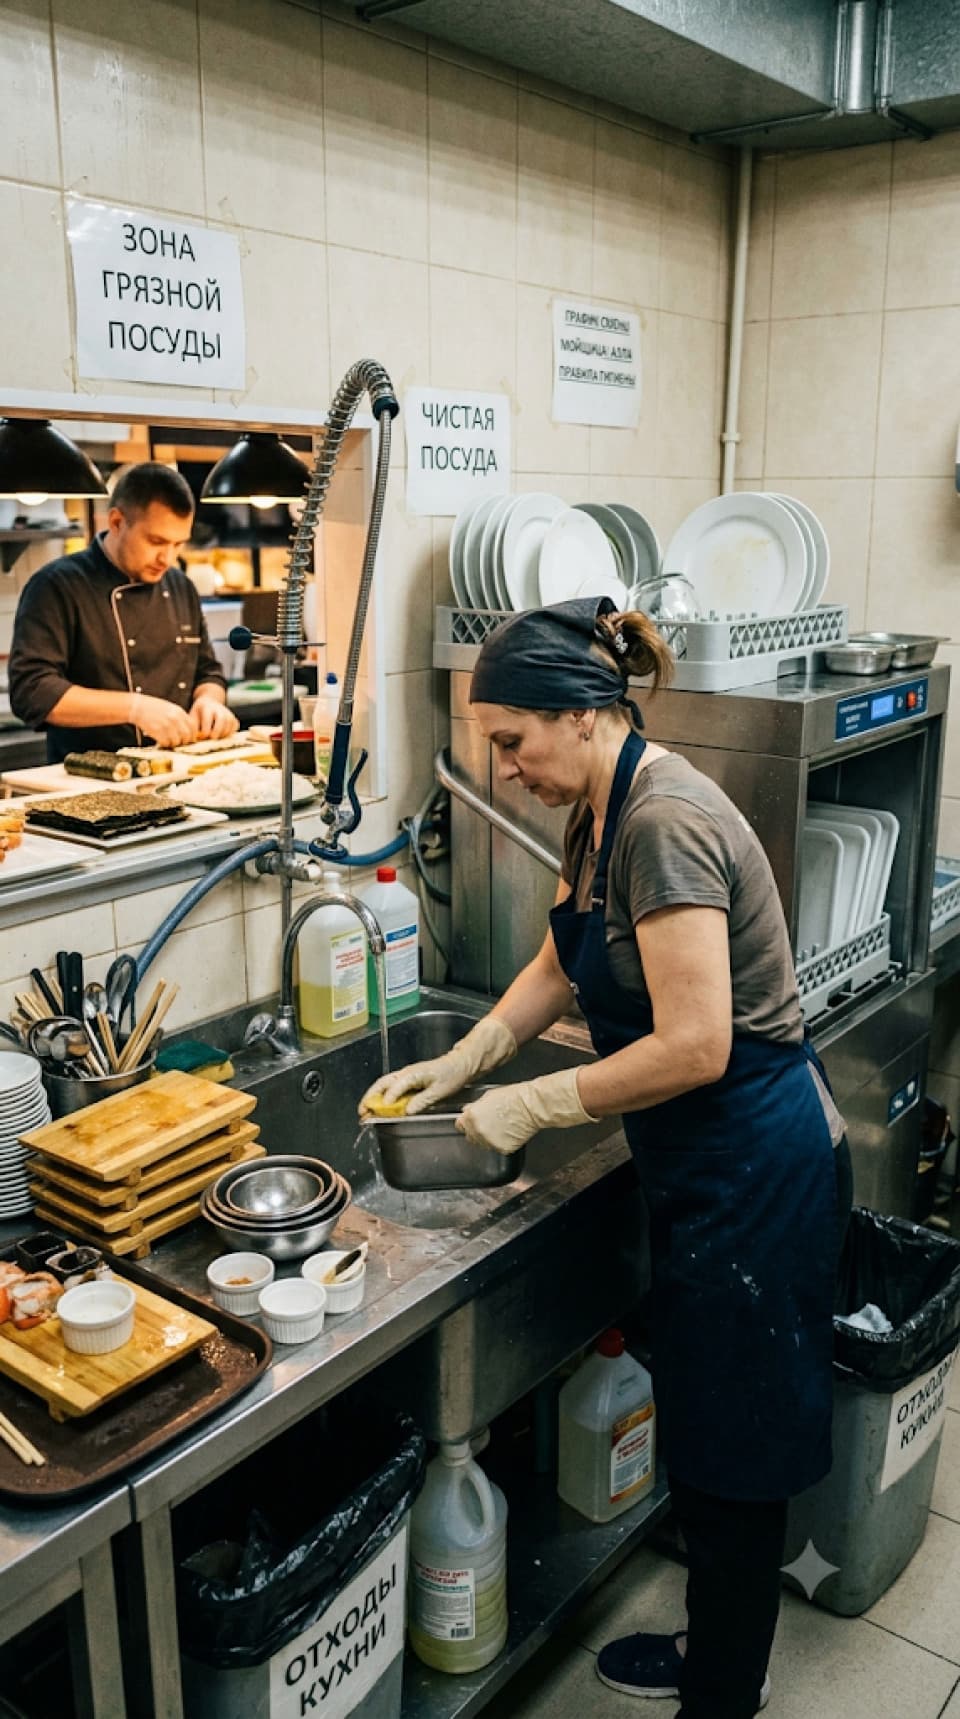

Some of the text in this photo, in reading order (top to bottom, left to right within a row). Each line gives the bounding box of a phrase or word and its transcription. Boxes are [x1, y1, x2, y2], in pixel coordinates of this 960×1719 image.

[122, 223, 196, 262] ЗОНА
[102, 269, 222, 312] ГРЯЗНОЙ
[108, 320, 221, 363] ПОСУДЫ
[422, 402, 494, 431] ЧИСТАЯ
[421, 445, 498, 477] ПОСУДА
[285, 1562, 396, 1686] ОТХОДЫ
[300, 1612, 386, 1717] КУХНИ
